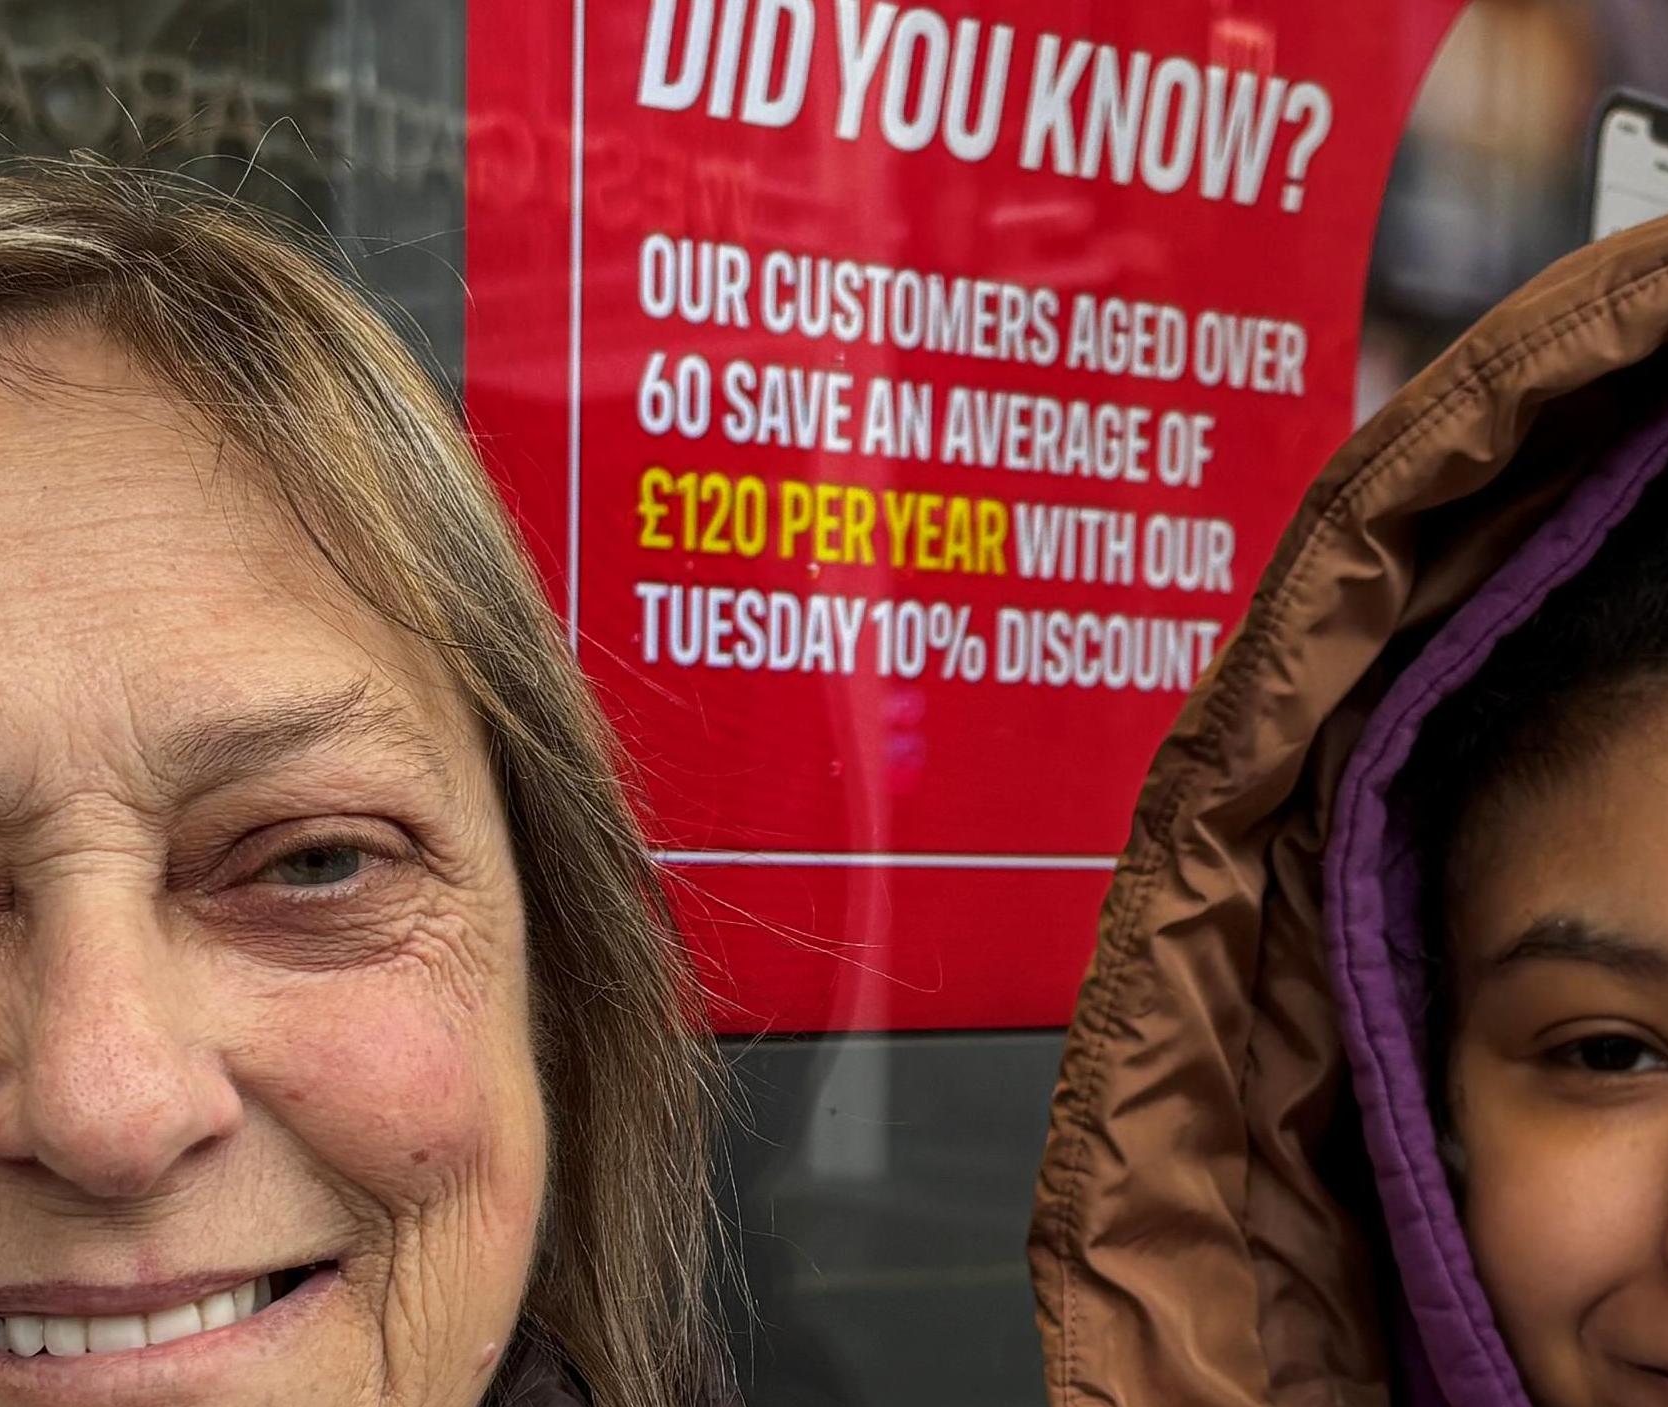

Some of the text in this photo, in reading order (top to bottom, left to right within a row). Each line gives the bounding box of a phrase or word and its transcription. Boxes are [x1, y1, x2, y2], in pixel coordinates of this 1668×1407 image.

[636, 0, 1333, 214] DID YOU KNOW?
[638, 233, 1308, 396] OUR CUSTOMERS AGED OVER
[638, 352, 1215, 487] 60 SAVE AN AVERAGE OF
[638, 467, 1233, 594] £120 PER YEAR WITH OUR
[634, 581, 1222, 693] TUESDAY 10% DISCOUNT
